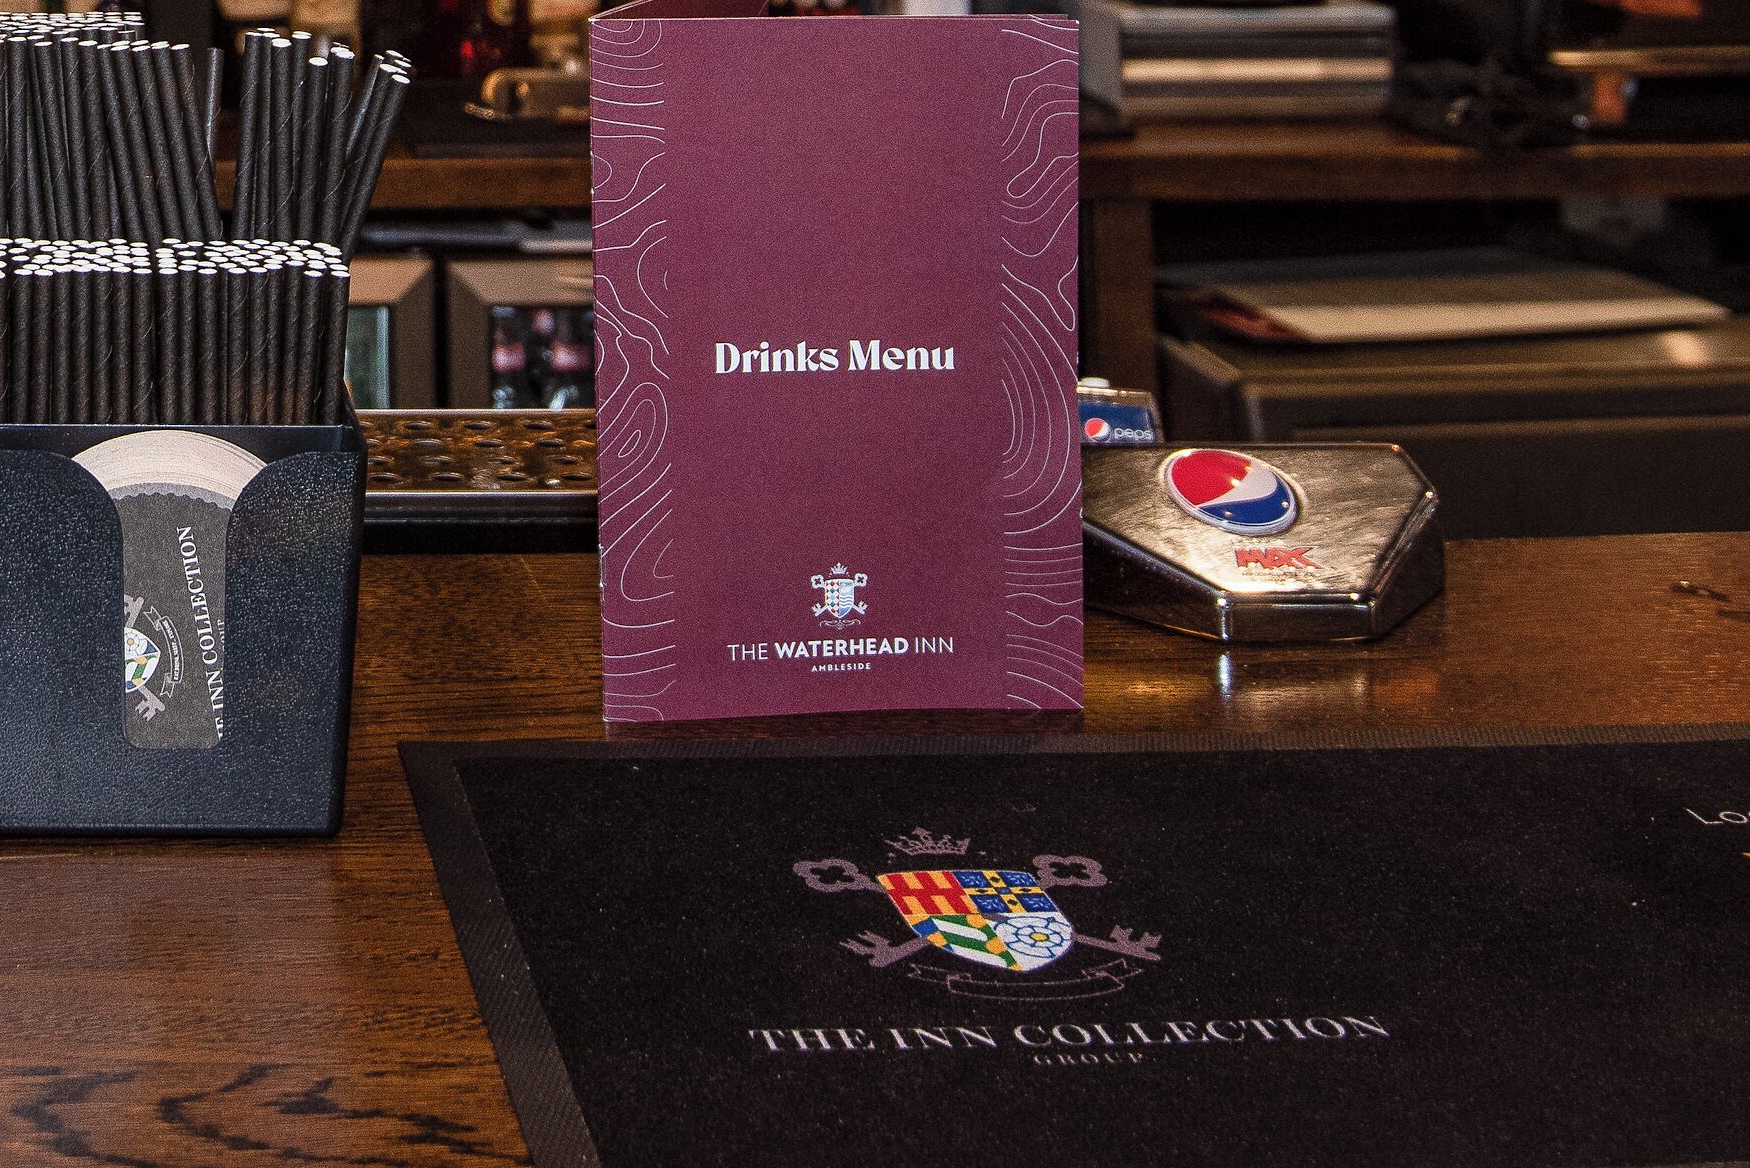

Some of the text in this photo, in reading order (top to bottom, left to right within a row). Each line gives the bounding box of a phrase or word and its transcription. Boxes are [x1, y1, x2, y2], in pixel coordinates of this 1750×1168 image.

[714, 339, 955, 374] Drinks Menu
[1234, 546, 1323, 570] MAX
[176, 526, 218, 665] COLLECTION
[727, 636, 954, 662] THE WATERHEAD INN
[811, 662, 872, 673] AMBLESIDE
[749, 1013, 1391, 1052] THE INN COLLECTION
[1033, 1050, 1149, 1066] GROUP
